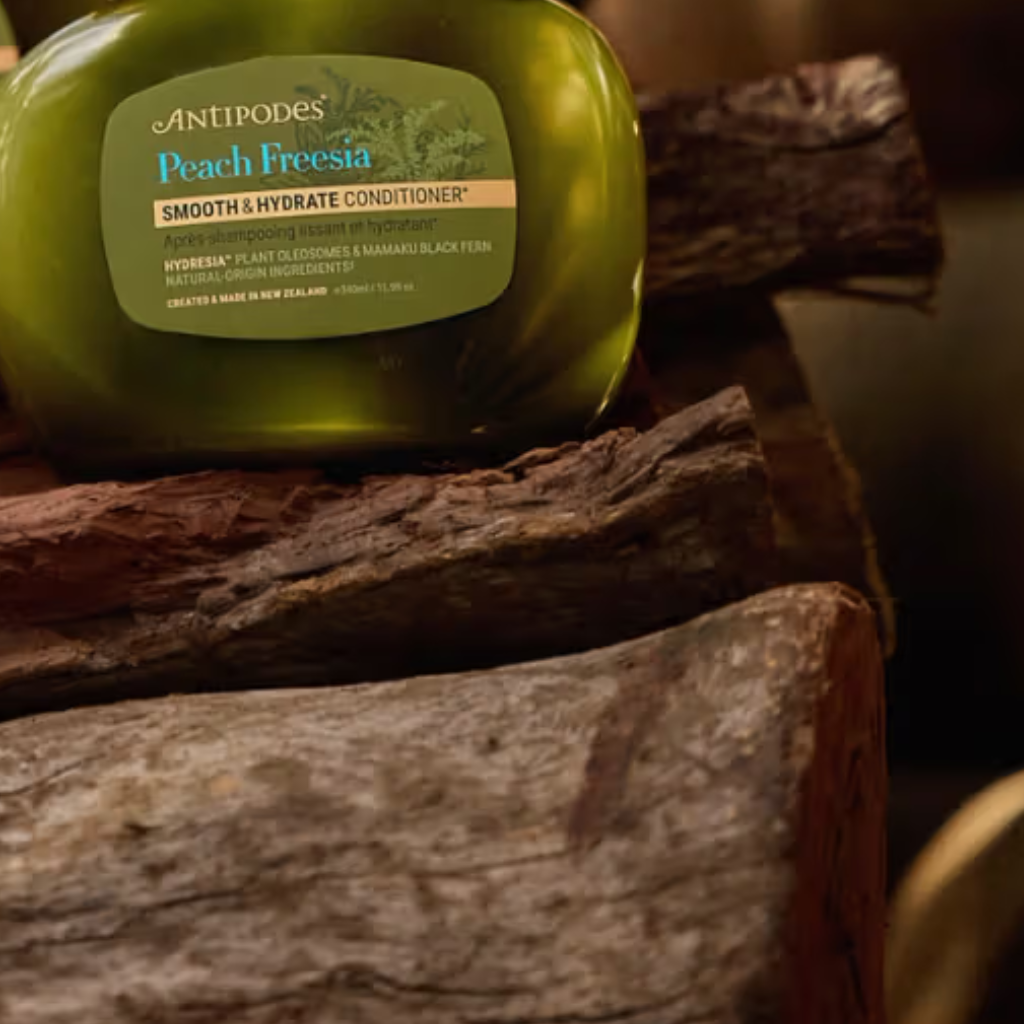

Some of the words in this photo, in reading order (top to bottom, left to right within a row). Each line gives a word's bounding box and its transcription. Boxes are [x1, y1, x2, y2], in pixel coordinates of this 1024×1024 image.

[158, 144, 252, 184] Peach
[260, 135, 372, 173] Freesia
[162, 199, 238, 222] SMOOTH
[242, 199, 253, 214] &
[257, 191, 340, 213] HYDRATE
[235, 250, 277, 266] PLANT
[277, 245, 350, 262] OLEOSOMES
[352, 245, 361, 258] &
[362, 242, 418, 258] MAMAKU
[420, 240, 460, 255] BLACK
[460, 239, 493, 254] FERN
[166, 266, 268, 288] NATURAL-ORIGIN
[167, 294, 210, 309] CREATED
[211, 294, 218, 305] &
[219, 291, 247, 304] MADE
[248, 291, 260, 301] IN
[260, 288, 282, 300] NEW
[283, 286, 328, 299] ZEALAND
